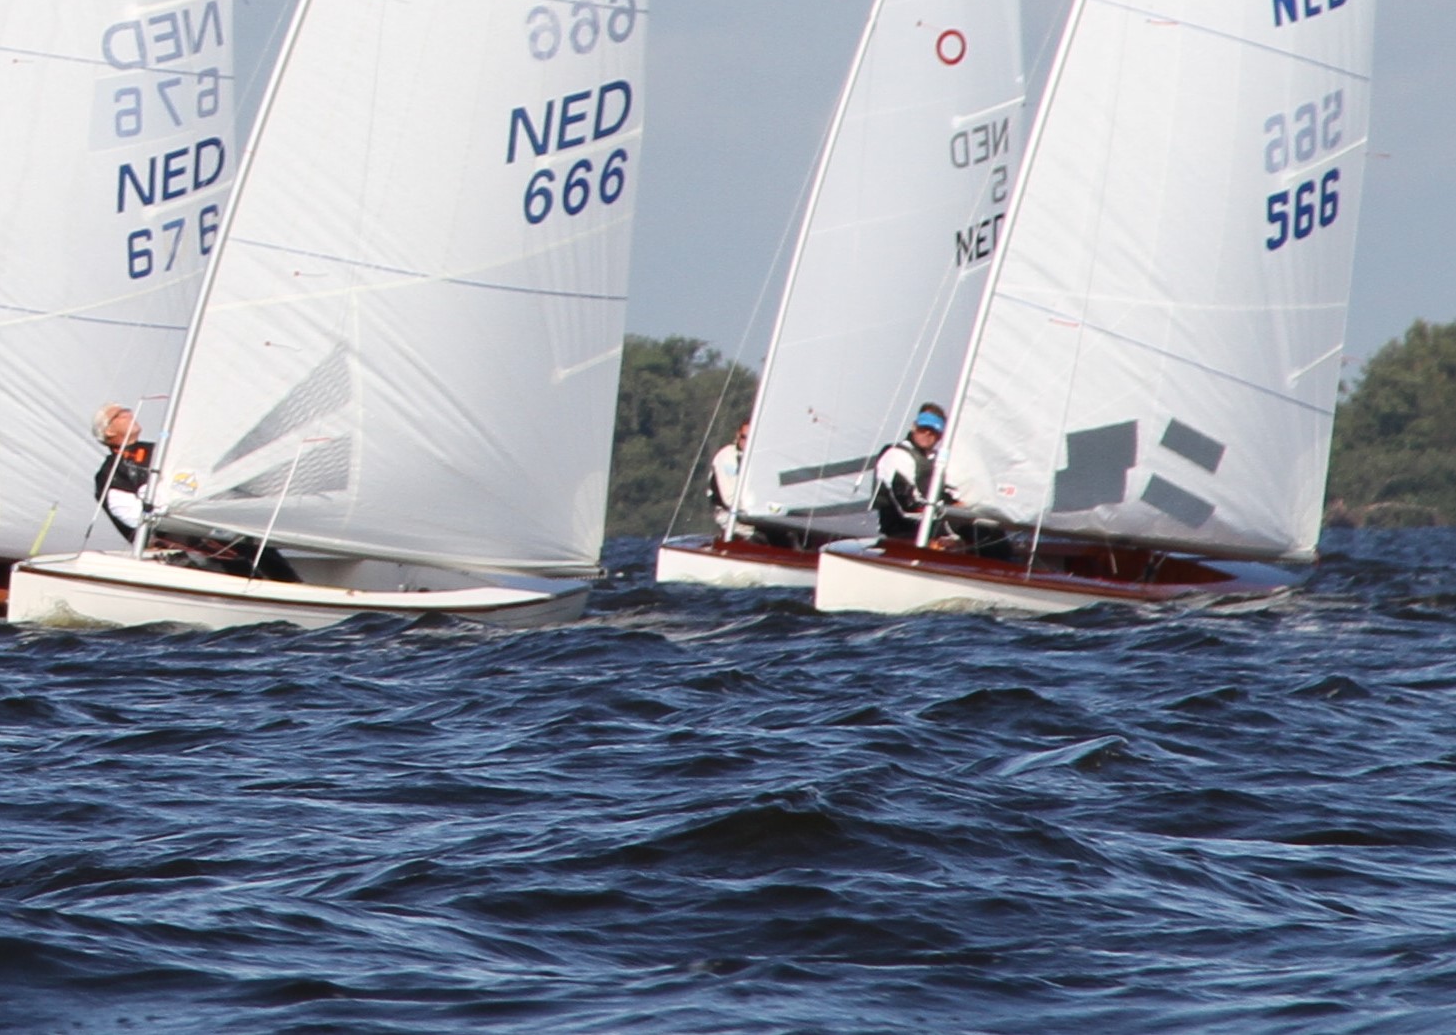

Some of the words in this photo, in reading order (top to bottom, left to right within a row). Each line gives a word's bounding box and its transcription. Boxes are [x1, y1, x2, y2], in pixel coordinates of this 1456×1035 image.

[506, 79, 632, 164] NED
[116, 137, 225, 214] NED
[523, 148, 628, 225] 666
[1265, 167, 1341, 251] 566
[127, 204, 218, 279] 676
